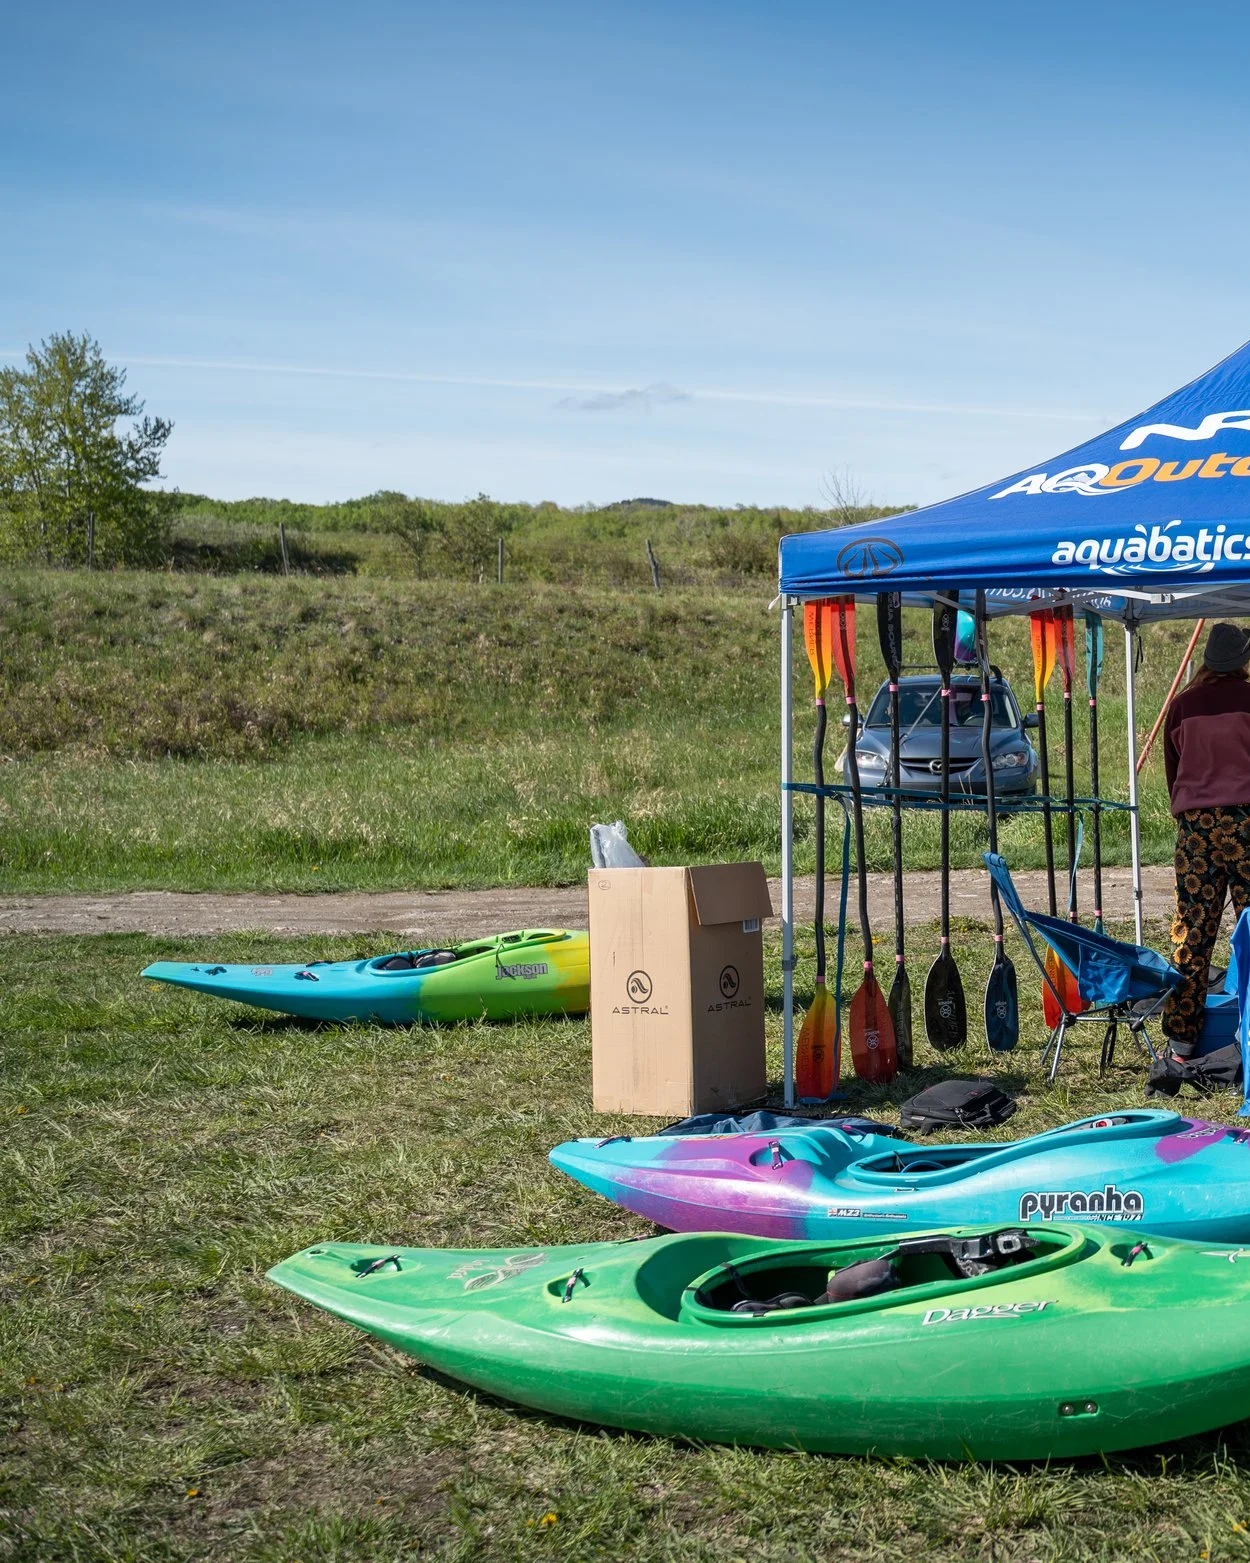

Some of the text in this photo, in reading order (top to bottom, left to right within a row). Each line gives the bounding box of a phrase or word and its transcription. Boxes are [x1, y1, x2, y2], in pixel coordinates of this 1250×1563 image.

[838, 1208, 861, 1217] MZ3
[1019, 1184, 1144, 1222] pyranha
[921, 1300, 1059, 1326] Dagger
